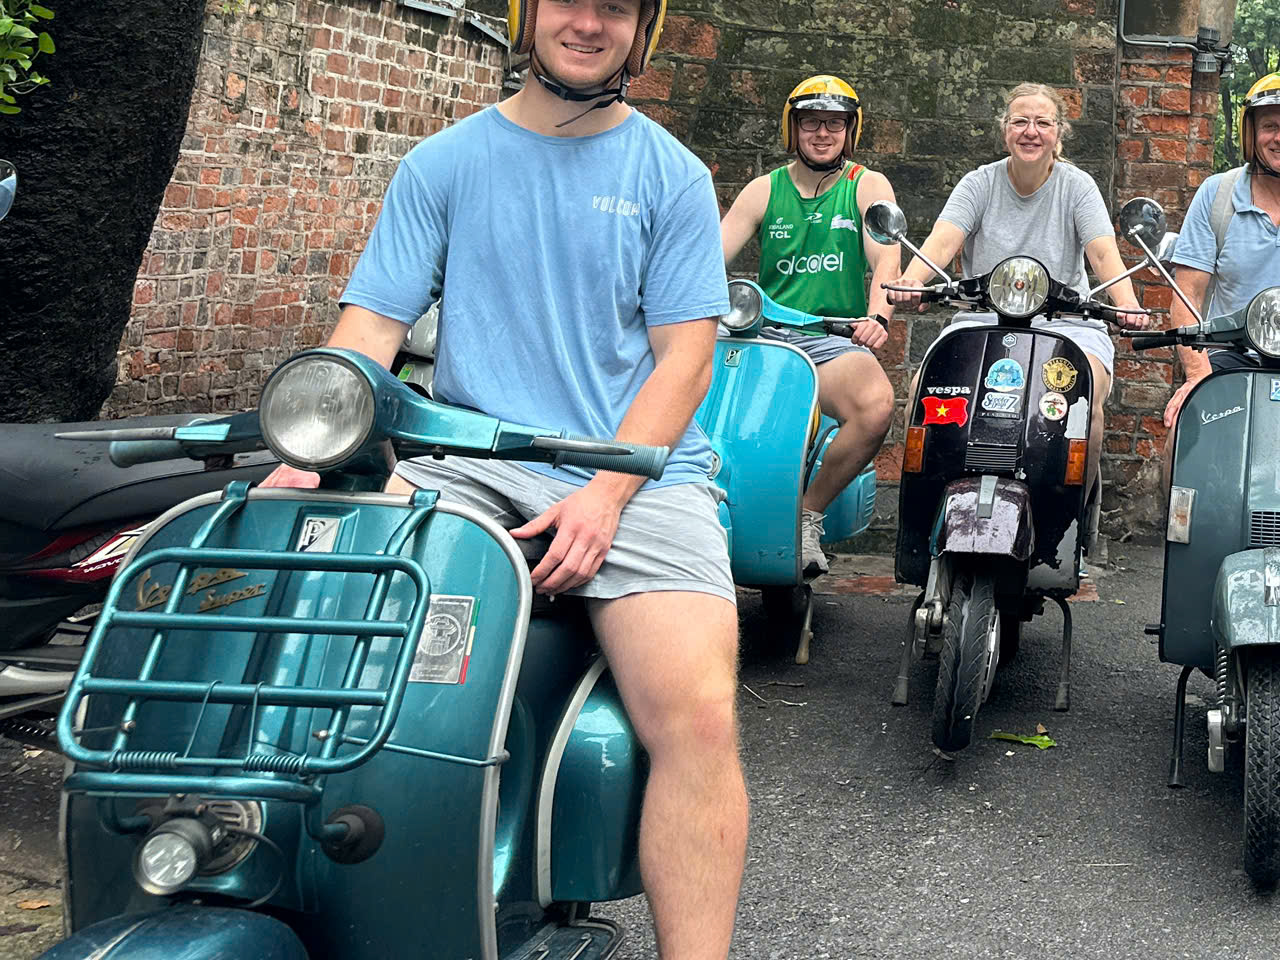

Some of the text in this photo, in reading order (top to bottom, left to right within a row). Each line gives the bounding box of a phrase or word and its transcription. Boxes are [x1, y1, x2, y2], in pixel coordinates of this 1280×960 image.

[769, 231, 791, 239] TCL
[927, 386, 971, 395] vespa
[1201, 406, 1245, 425] Vespa
[135, 568, 248, 612] Vepa
[196, 583, 267, 613] Super
